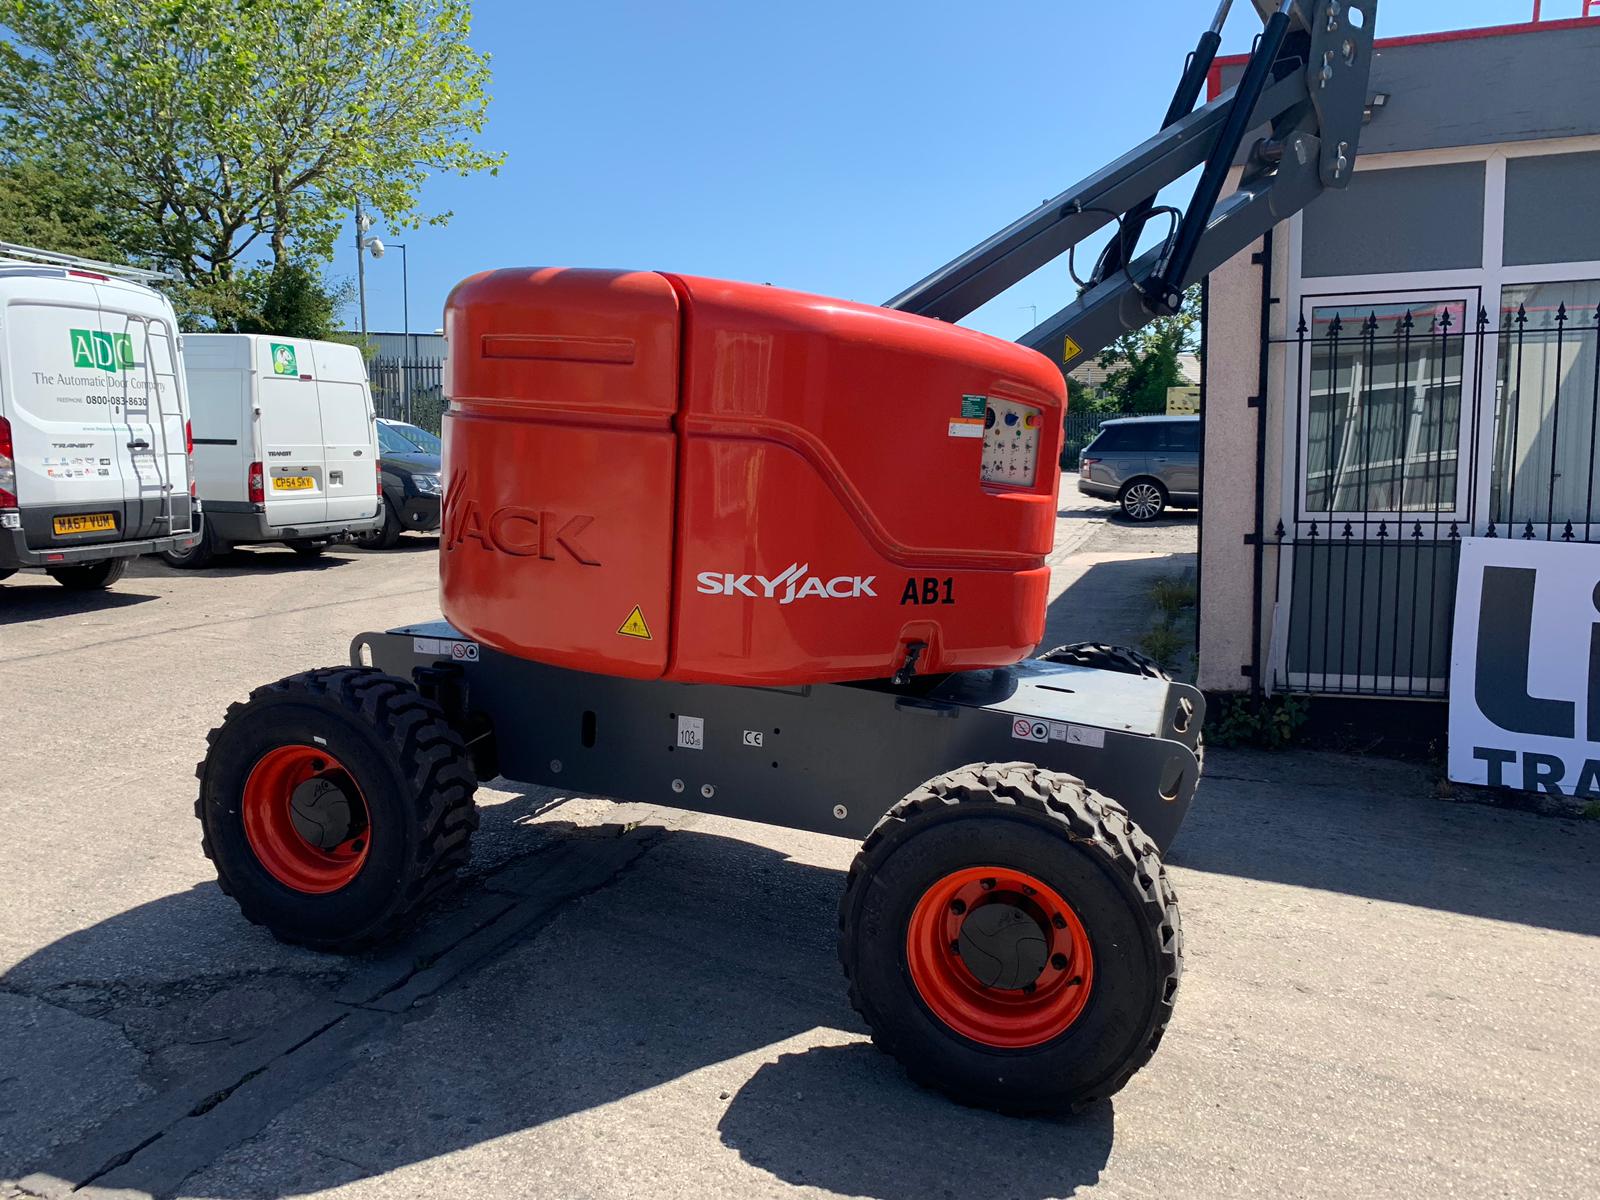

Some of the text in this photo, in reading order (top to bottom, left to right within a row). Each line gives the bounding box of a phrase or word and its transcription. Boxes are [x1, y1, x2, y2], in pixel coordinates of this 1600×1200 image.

[74, 335, 132, 367] ADC
[32, 372, 166, 393] The Automatic Door Company
[86, 395, 148, 406] 0800-083-8630
[275, 476, 312, 488] CP54 SKY
[58, 516, 87, 531] MA67
[696, 562, 878, 605] SKYJACK
[900, 576, 956, 605] AB1
[680, 729, 695, 746] 103
